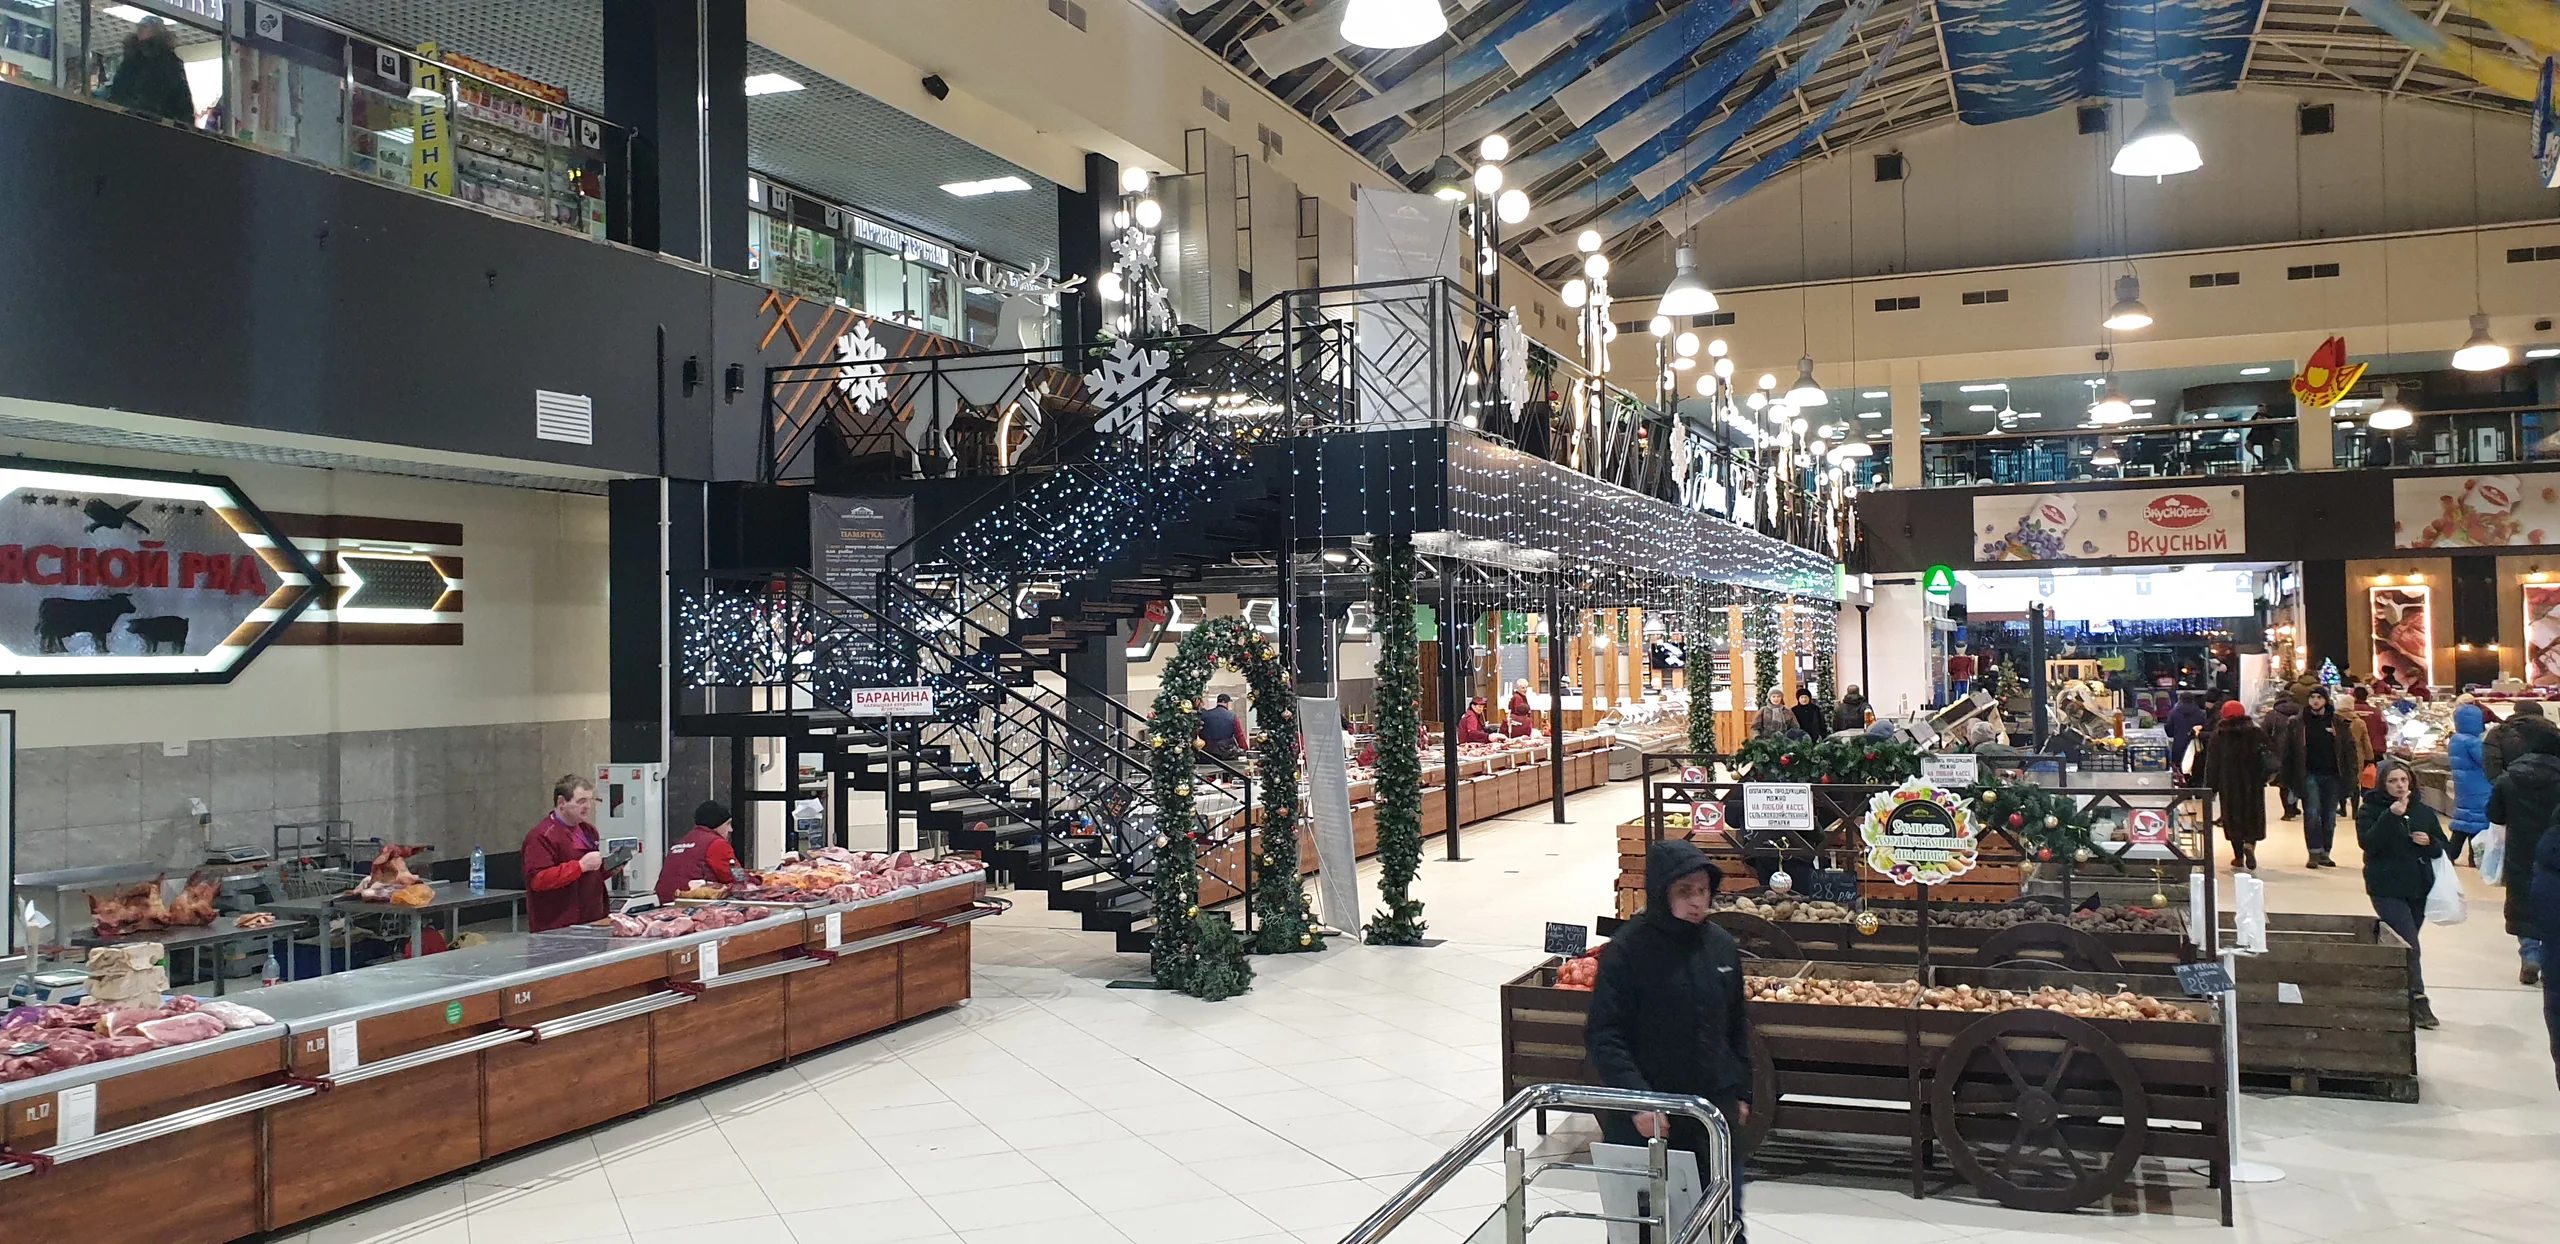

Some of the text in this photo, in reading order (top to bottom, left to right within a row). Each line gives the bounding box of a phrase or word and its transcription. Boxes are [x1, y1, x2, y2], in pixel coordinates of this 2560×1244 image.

[2127, 529, 2227, 555] Вкусный
[0, 540, 267, 597] ЯСНОЙ РЯД
[857, 691, 929, 703] БАРАНИНА
[1762, 802, 1784, 810] ЛЮБОЙ
[1812, 882, 1834, 900] 28
[2187, 976, 2210, 992] 28
